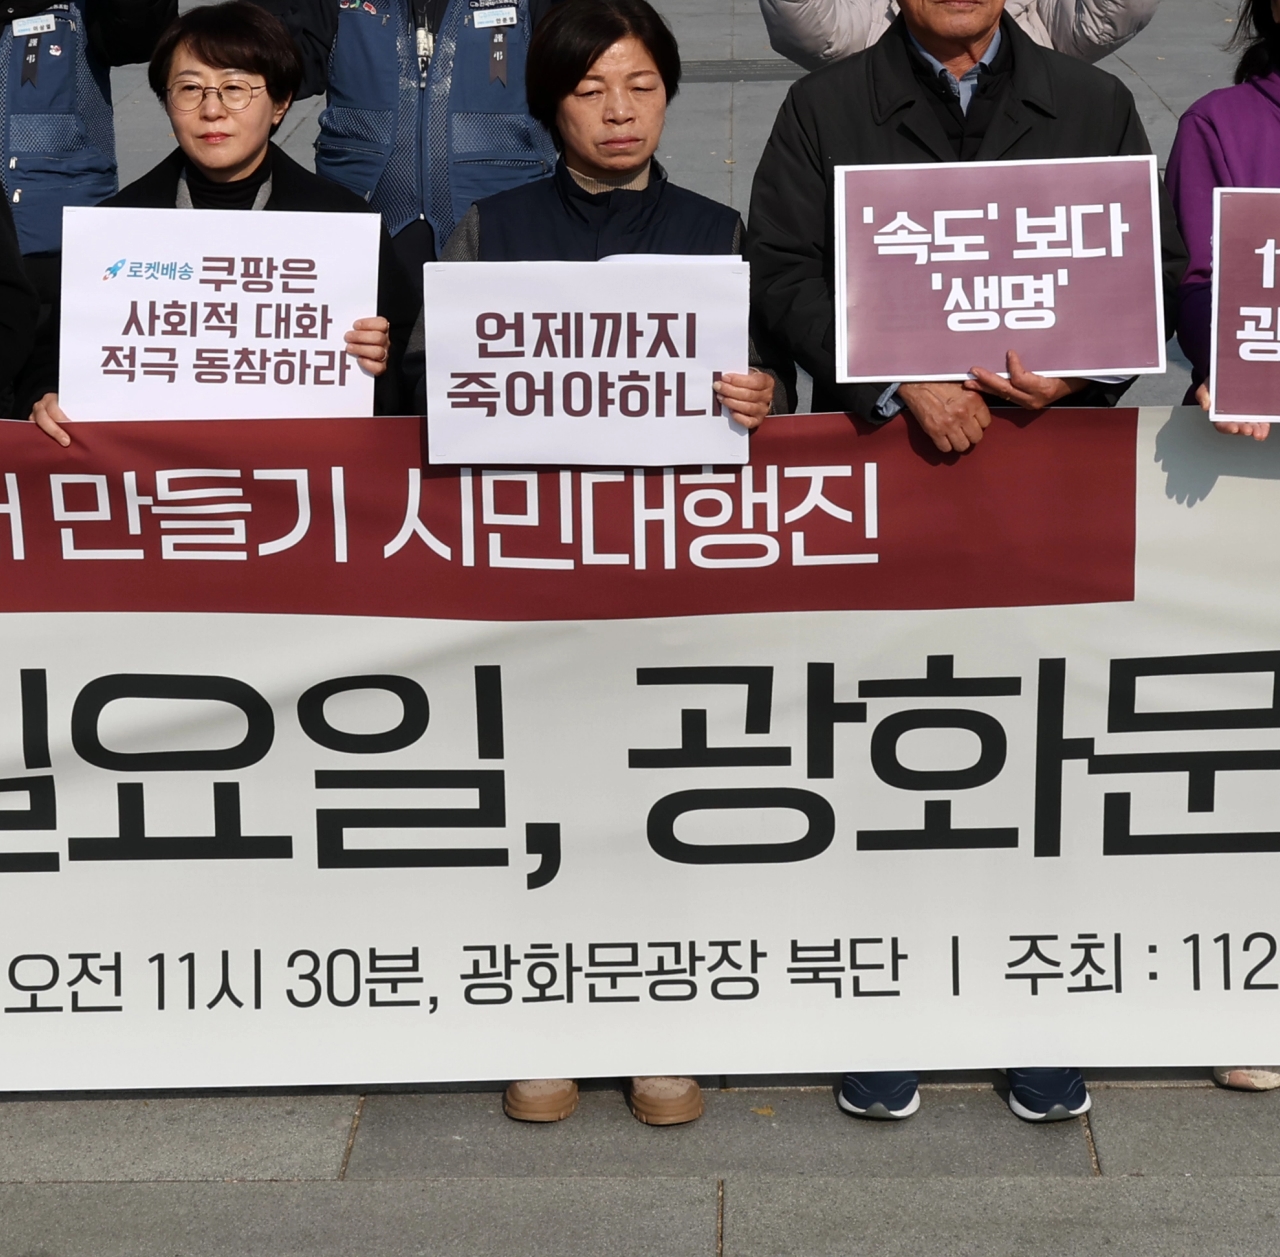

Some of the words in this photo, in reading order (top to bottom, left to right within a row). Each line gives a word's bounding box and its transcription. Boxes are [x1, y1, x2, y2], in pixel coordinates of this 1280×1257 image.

[862, 202, 999, 265] '속도'
[1012, 202, 1130, 259] 보다
[126, 261, 194, 281] 로켓배송
[198, 256, 318, 294] 쿠팡은
[931, 268, 1069, 332] '생명'
[121, 300, 238, 339] 사회적
[254, 302, 333, 340] 대화
[475, 311, 697, 359] 언제까지
[100, 345, 179, 384] 적극
[192, 347, 351, 387] 동참하라
[50, 467, 347, 562] 만들기
[384, 466, 878, 569] 시민대행진
[5, 952, 122, 1013] 오전
[149, 949, 261, 1010] 11시
[286, 947, 437, 1014] 30분,
[460, 940, 766, 1005] 광화문광장
[787, 937, 908, 998] 북단
[1005, 933, 1122, 995] 주최
